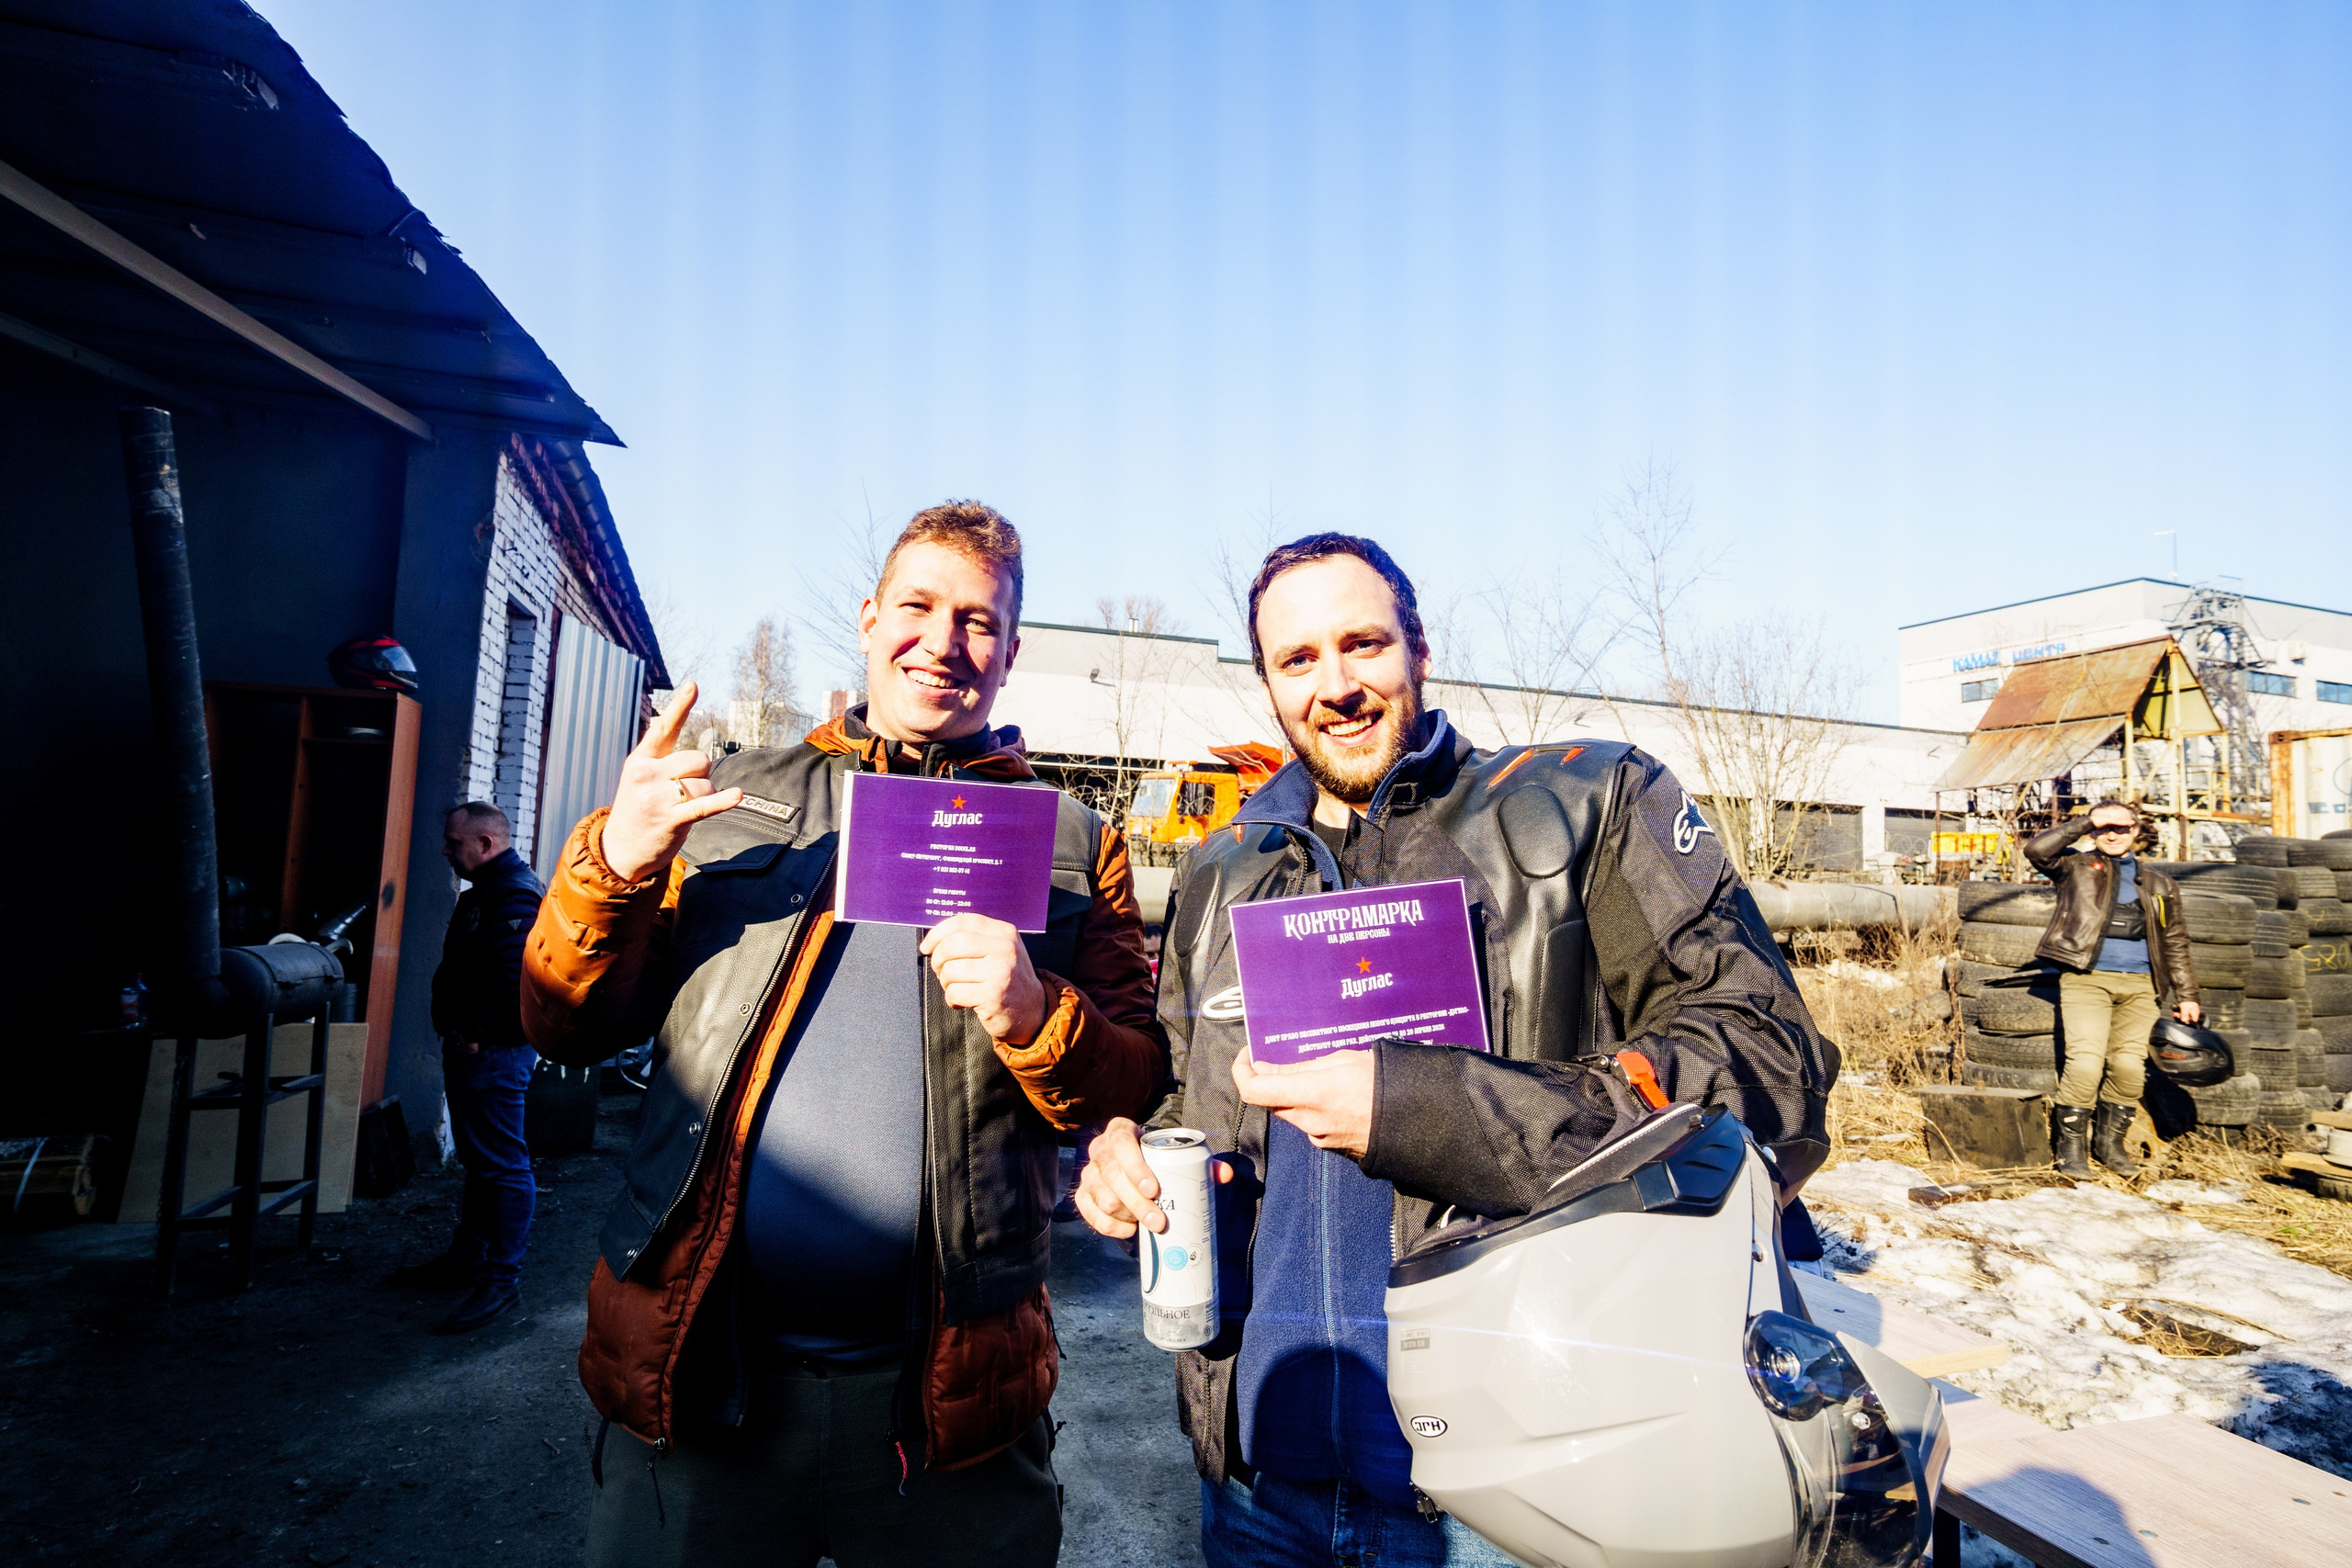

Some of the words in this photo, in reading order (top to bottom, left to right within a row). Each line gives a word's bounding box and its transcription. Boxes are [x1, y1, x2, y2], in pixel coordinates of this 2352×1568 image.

[932, 810, 983, 828] Дуглас
[1283, 899, 1425, 941] КОНТРАМАРКА
[1327, 934, 1339, 944] НА
[1339, 931, 1355, 944] ДВЕ
[1355, 928, 1390, 941] ПЕРСОНЫ
[1340, 972, 1394, 999] Дуглас
